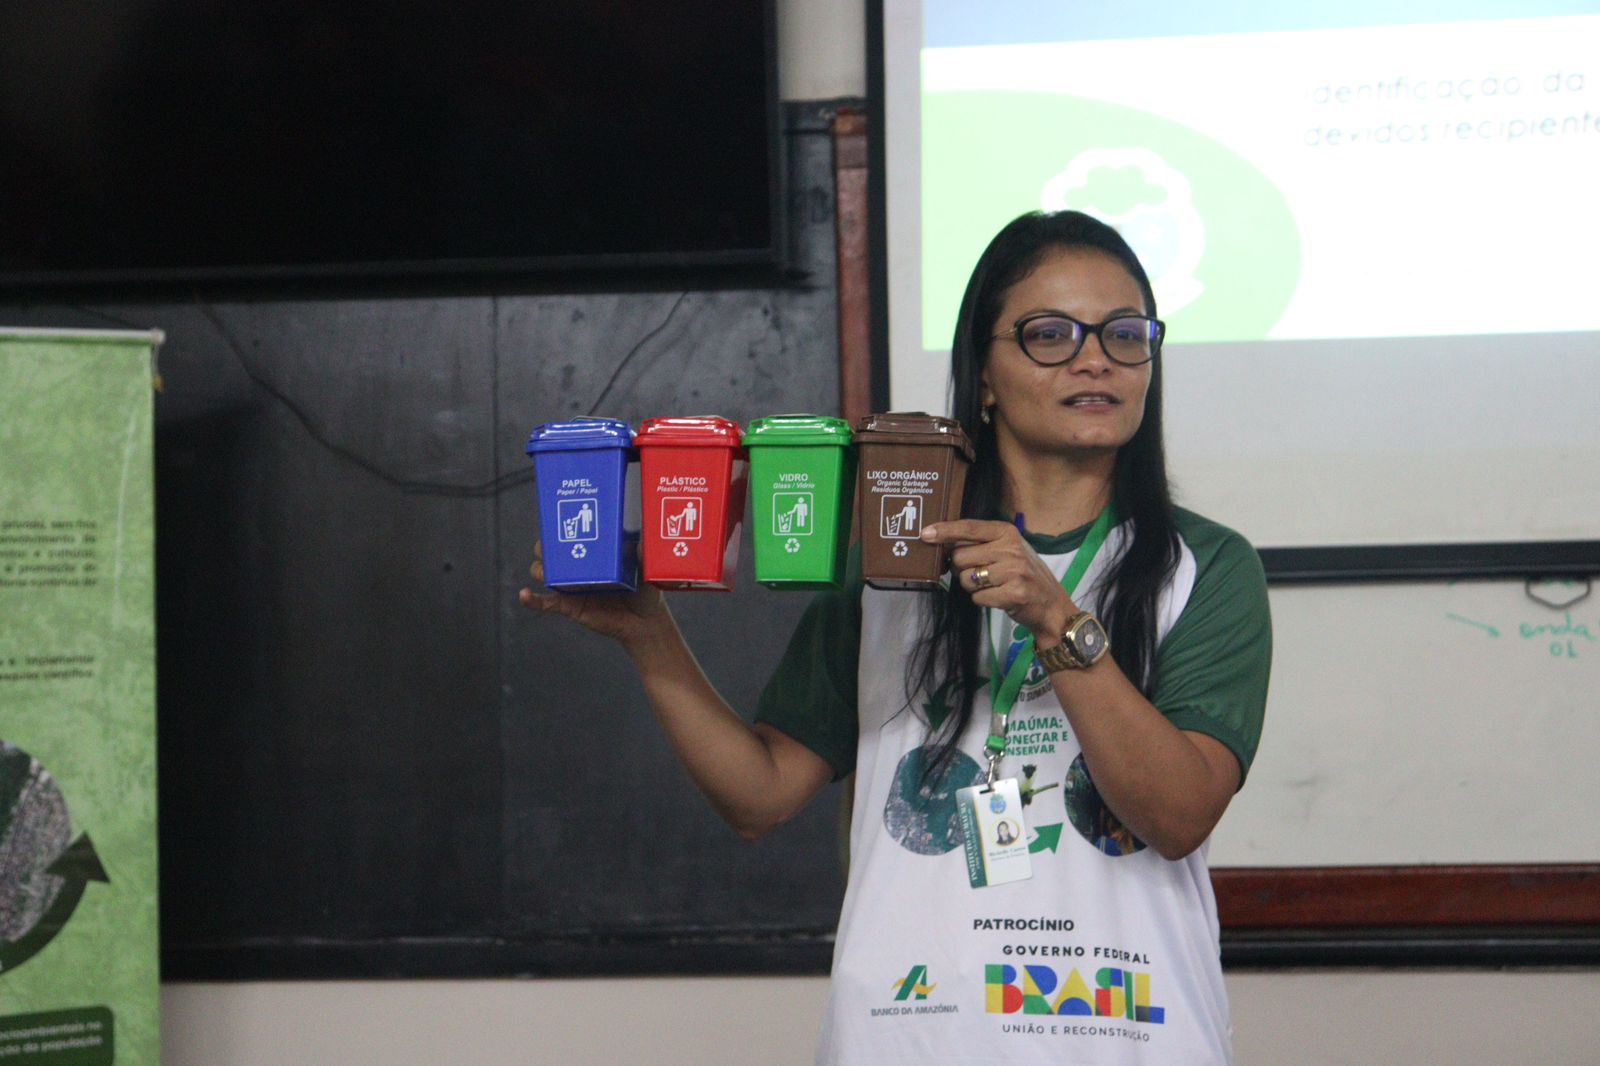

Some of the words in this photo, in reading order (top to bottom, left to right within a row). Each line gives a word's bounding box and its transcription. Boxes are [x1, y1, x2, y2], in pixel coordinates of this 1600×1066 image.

[1543, 70, 1586, 93] da
[660, 474, 706, 485] PLÁSTICO
[779, 473, 808, 482] VIDRO
[866, 471, 888, 480] LIXO
[890, 470, 939, 480] ORGÂNICO
[562, 479, 592, 488] PAPEL
[877, 480, 900, 488] Organic
[902, 480, 929, 488] Garbage
[557, 488, 576, 496] Paper
[580, 487, 598, 495] Papel
[1008, 716, 1063, 731] MAÚMA:
[1006, 732, 1058, 745] ONECTAR
[1062, 731, 1069, 741] E
[1007, 744, 1056, 756] NSERVAR
[973, 917, 1074, 931] PATROCÍNIO
[1003, 945, 1085, 956] GOVERNO
[1094, 947, 1150, 964] FEDERAL
[985, 964, 1165, 1024] BRASIL
[871, 1007, 899, 1017] BANCO
[901, 1007, 912, 1015] DA
[915, 1003, 959, 1015] AMAZÔNIA
[1002, 1023, 1045, 1035] UNIÃO
[1051, 1025, 1058, 1035] E
[1064, 1026, 1150, 1042] RECONSTRUÇÃO
